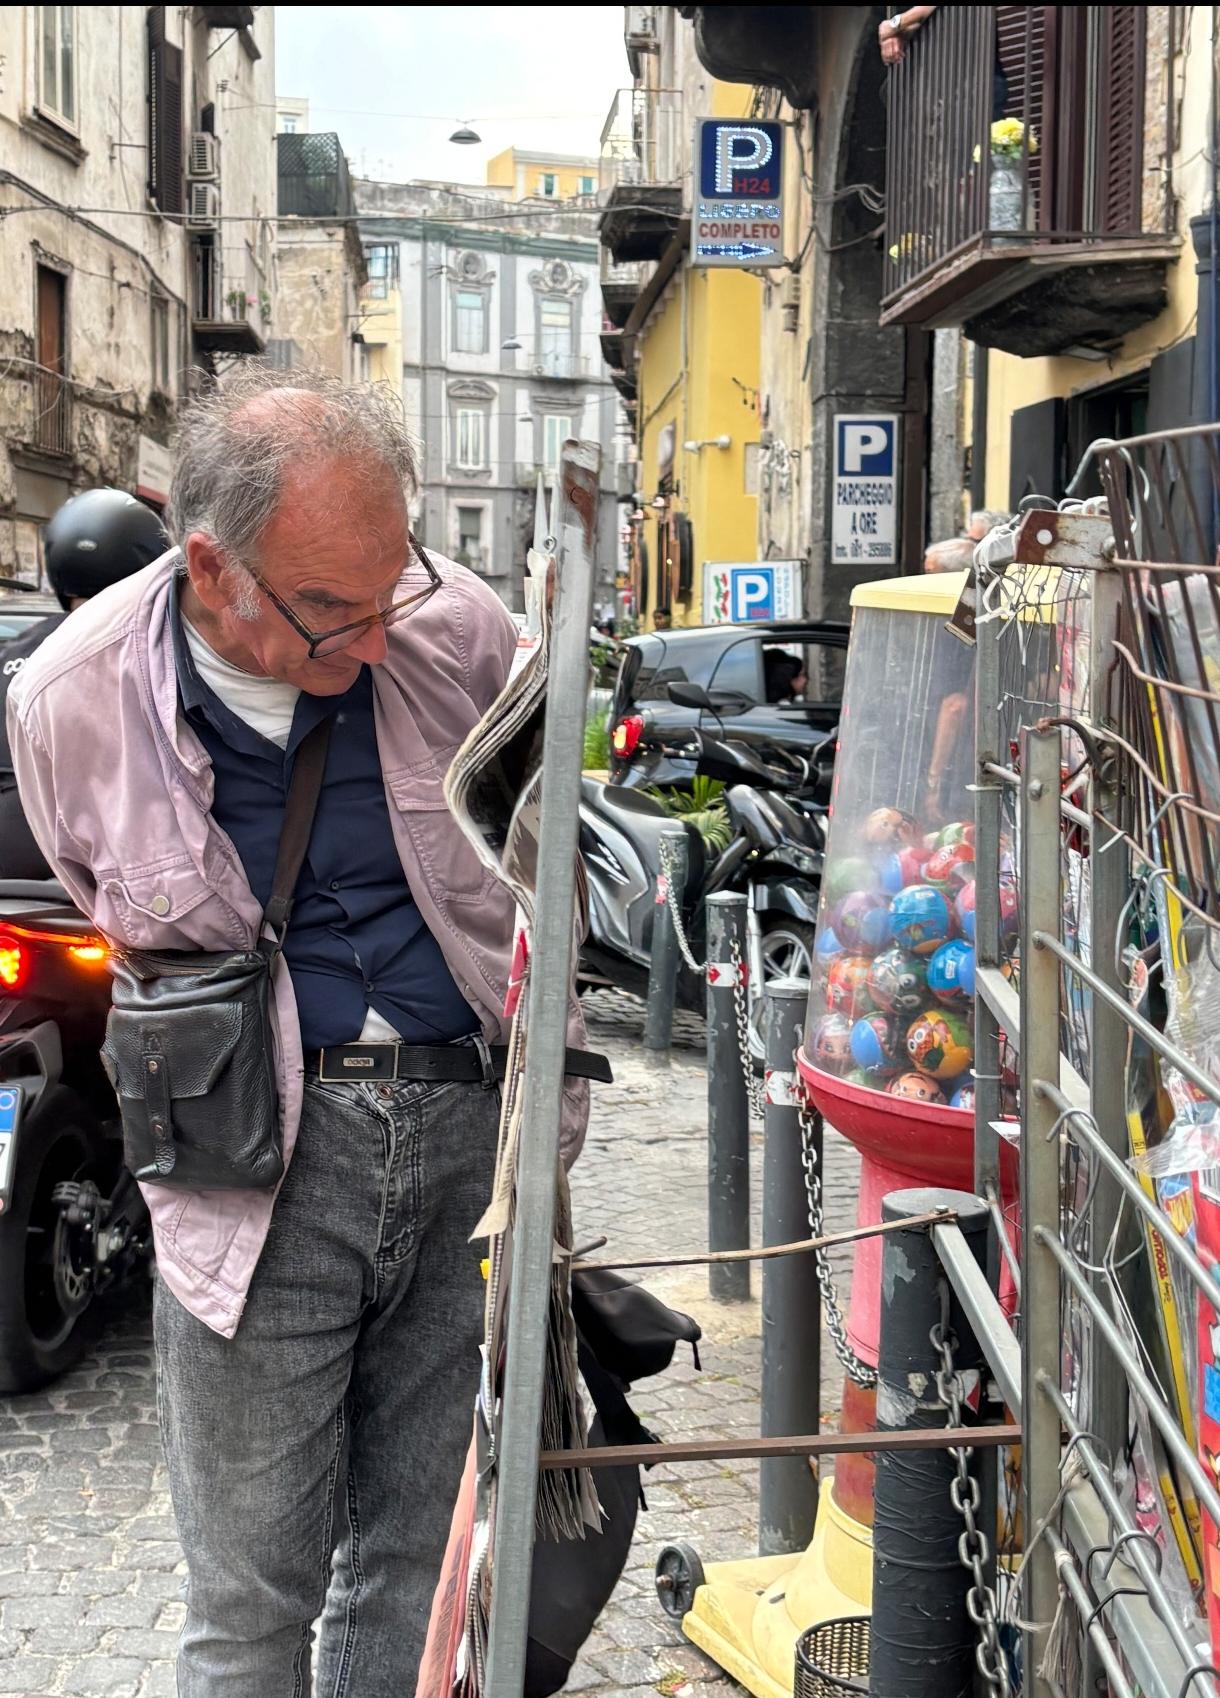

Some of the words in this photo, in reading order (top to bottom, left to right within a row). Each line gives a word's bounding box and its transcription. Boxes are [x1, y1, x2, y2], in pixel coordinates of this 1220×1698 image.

[715, 126, 772, 193] P
[734, 177, 770, 193] H24
[699, 223, 780, 239] COMPLETO
[844, 425, 887, 472] P
[837, 483, 893, 505] PARCHEGGIO
[850, 512, 858, 535] A
[860, 512, 877, 534] ORE
[737, 575, 768, 618] P
